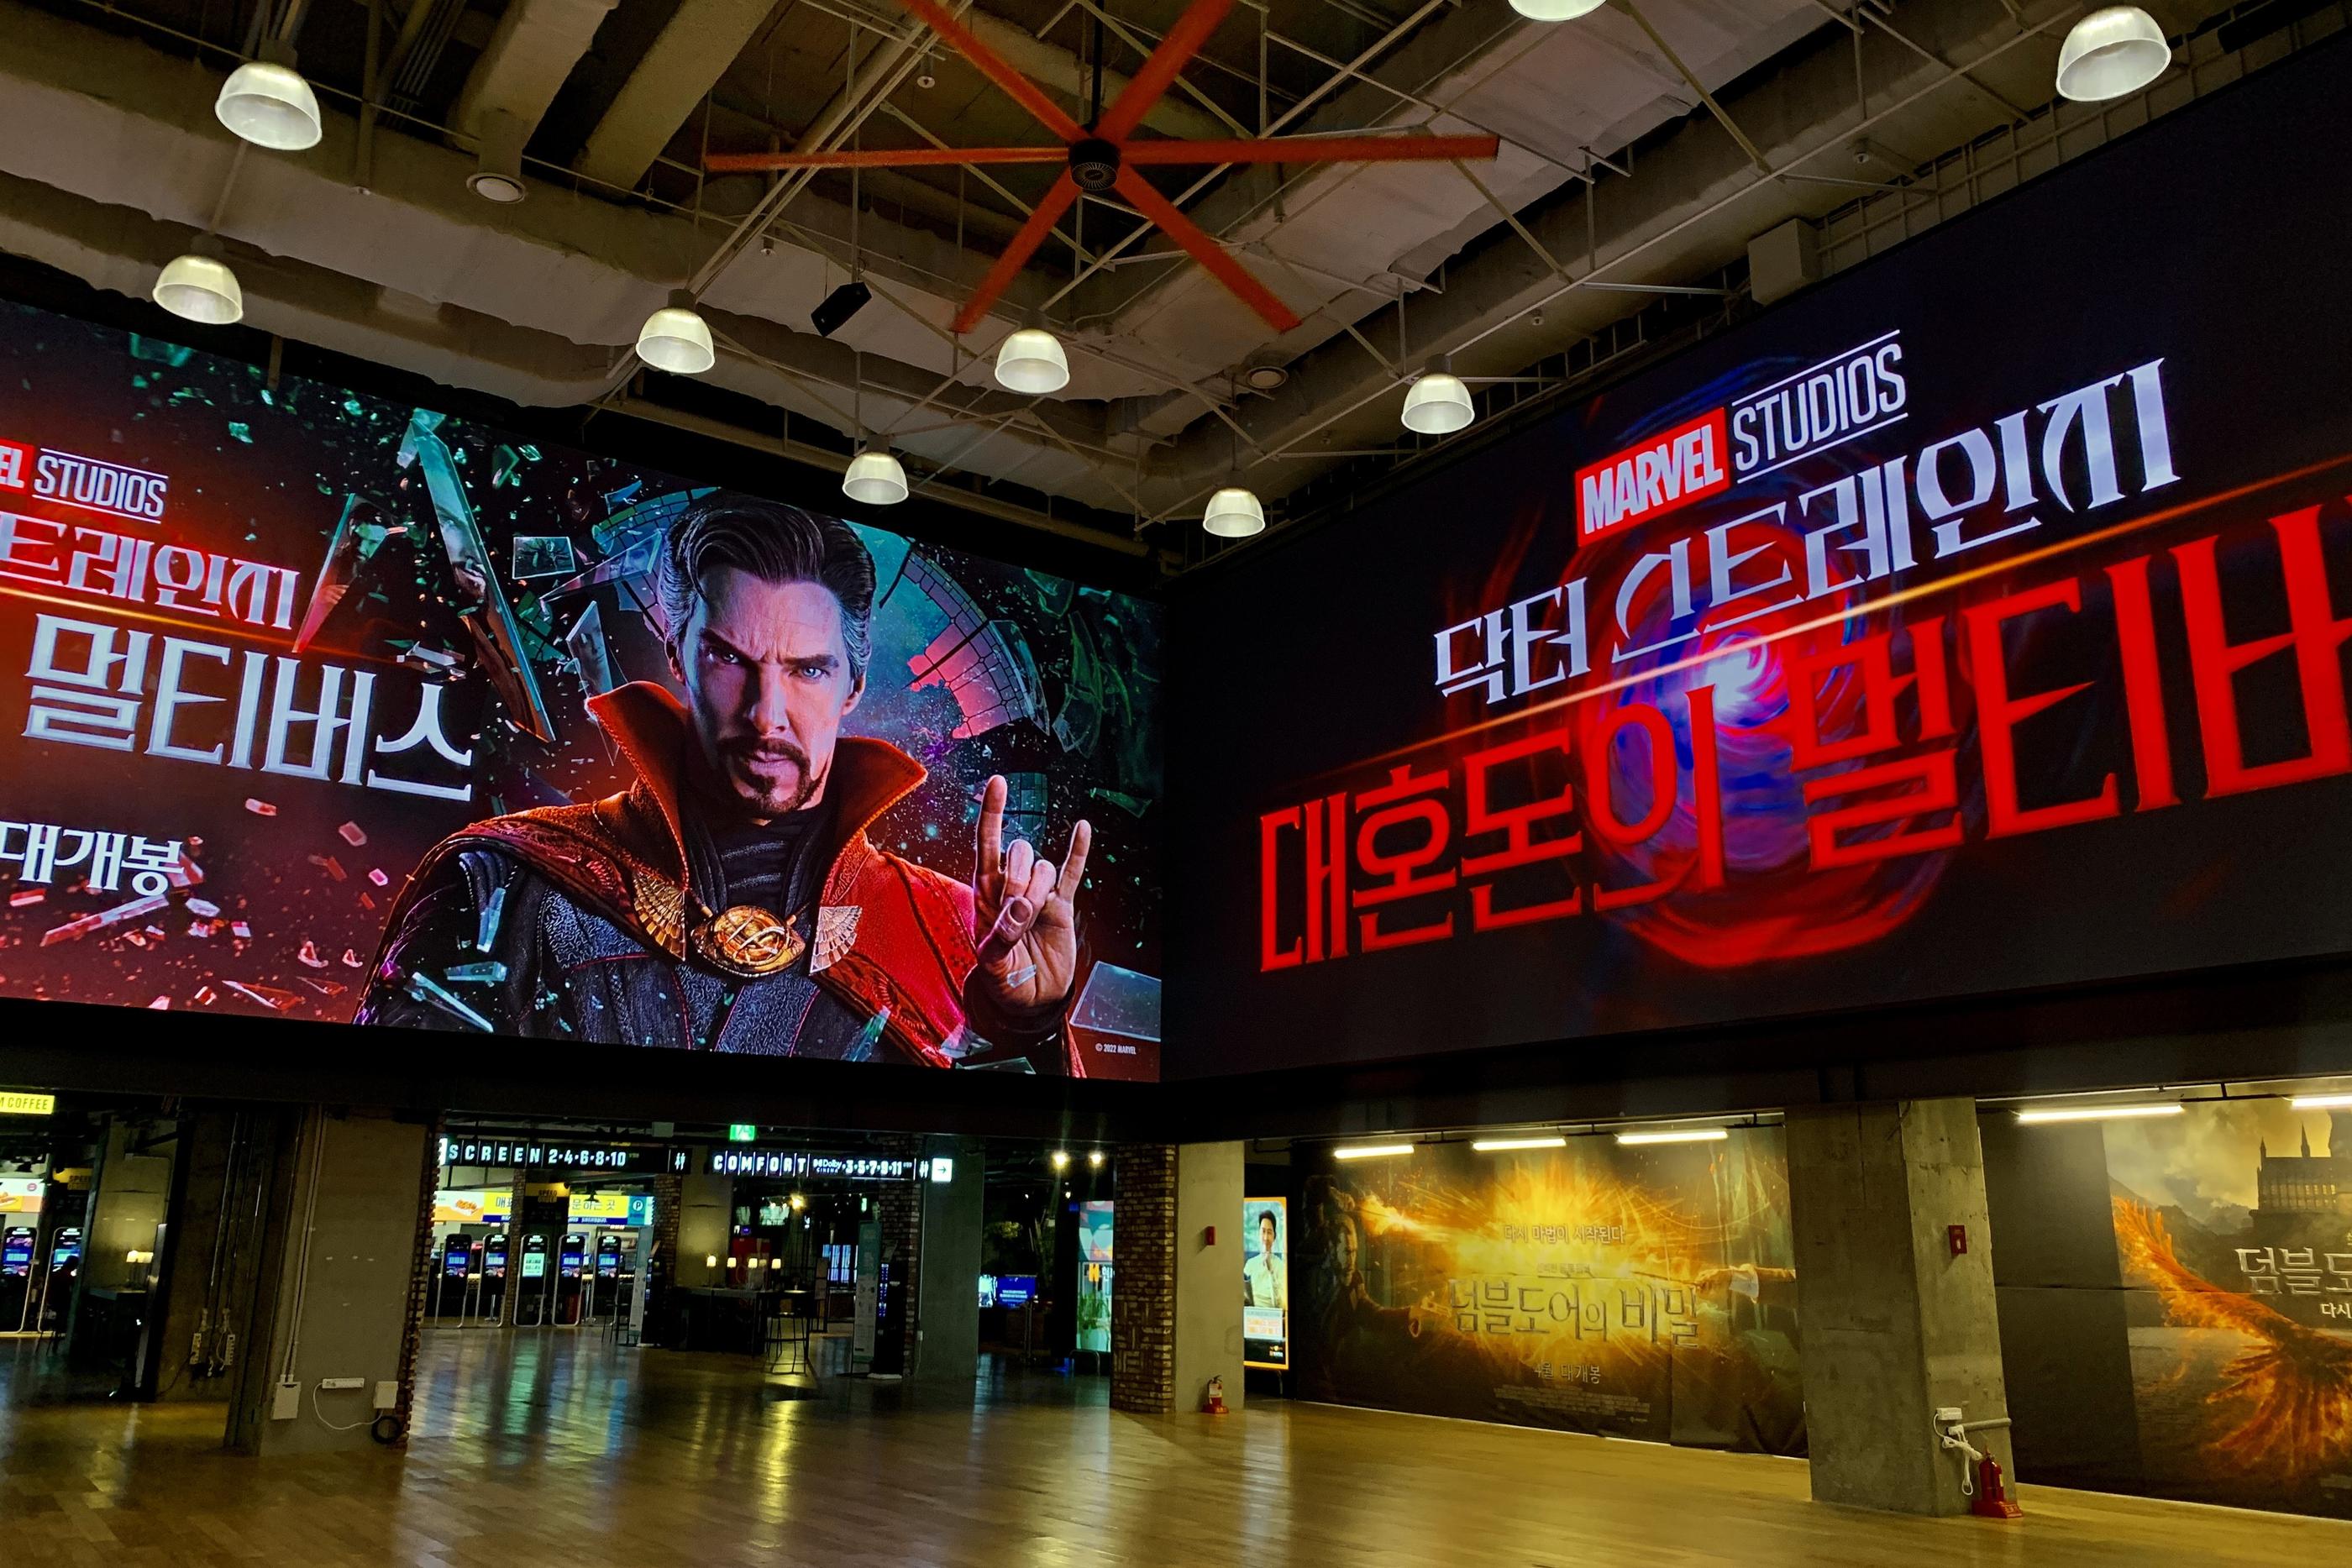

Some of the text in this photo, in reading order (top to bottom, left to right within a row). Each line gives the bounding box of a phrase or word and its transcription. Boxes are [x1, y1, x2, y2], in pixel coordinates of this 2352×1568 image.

[1580, 342, 1906, 537] MARVEL STUDIOS
[34, 454, 167, 518] STUDIOS
[1432, 356, 2182, 705] 닥터 스트레인지
[22, 612, 473, 802] 멀티버스
[1258, 684, 1726, 973] 대혼돈의
[0, 821, 185, 897] 대개봉
[1103, 1044, 1116, 1053] 2022
[1117, 1045, 1137, 1055] MARVEL
[8, 1097, 49, 1110] COFFEE
[449, 1144, 541, 1164] SCREEN
[713, 1155, 806, 1173] COMFORT
[822, 1158, 842, 1169] Dolby
[1504, 1224, 1625, 1245] 다시 마법이 시작된다
[1448, 1278, 1699, 1349] 덤블도어의 비밀
[2319, 1302, 2352, 1319] 다시
[1560, 1364, 1602, 1385] 대개봉
